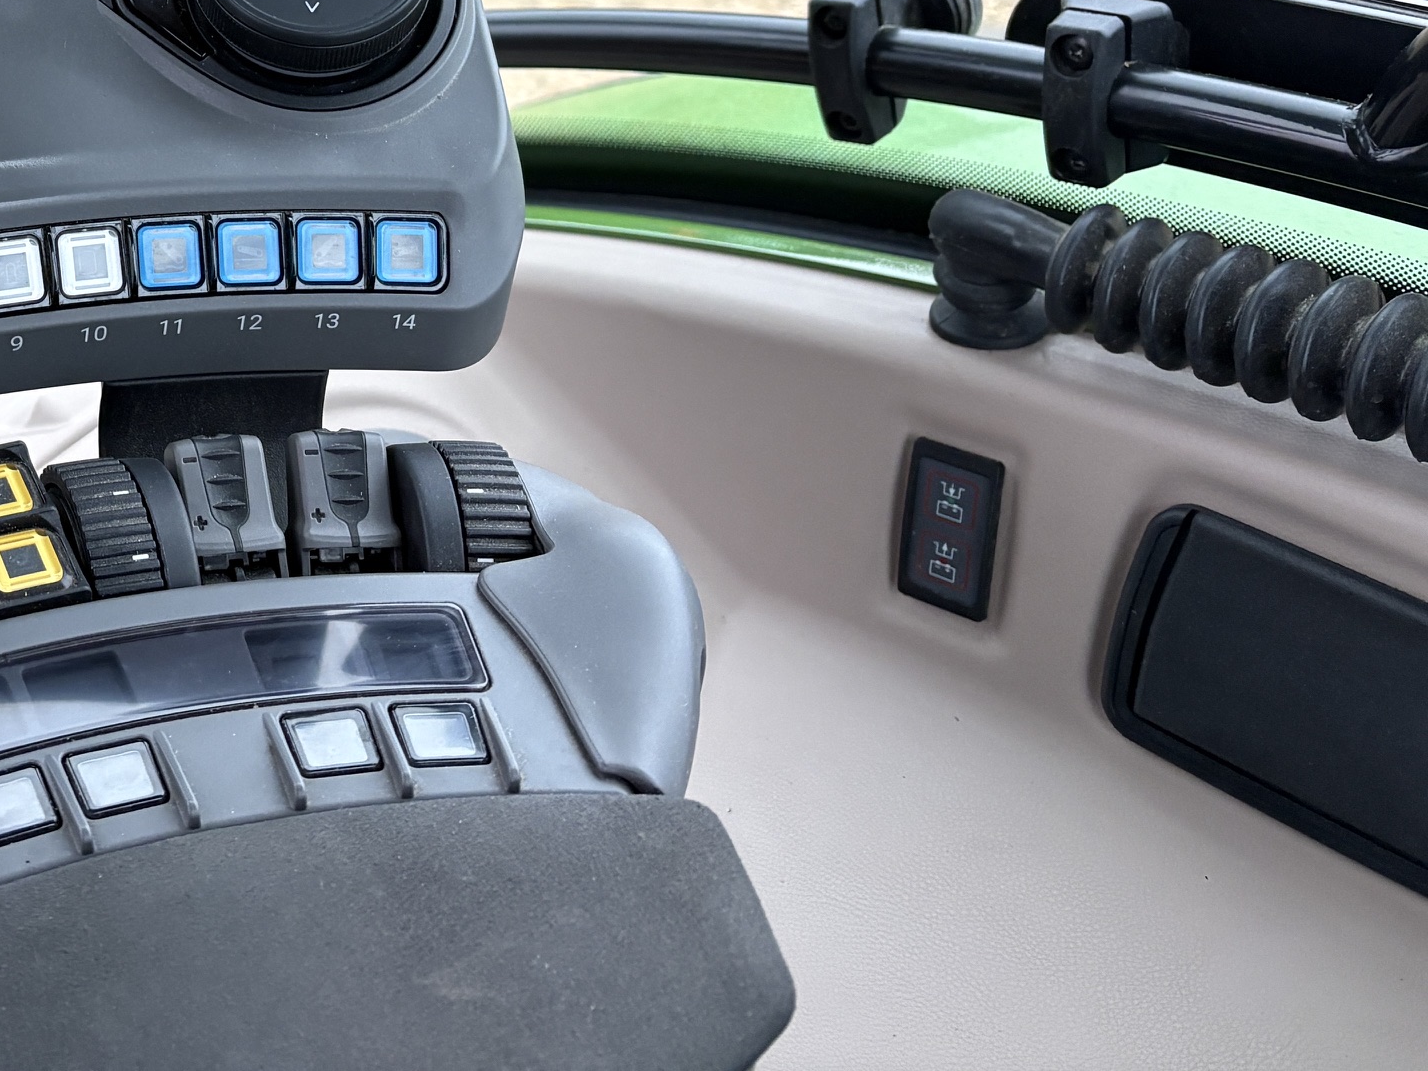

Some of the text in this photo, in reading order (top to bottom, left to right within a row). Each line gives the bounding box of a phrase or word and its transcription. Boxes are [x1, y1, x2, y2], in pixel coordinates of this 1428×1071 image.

[10, 335, 24, 352] 9
[80, 325, 108, 343] 10
[159, 318, 183, 336] 11
[237, 314, 263, 331] 12
[314, 312, 340, 329] 13
[392, 313, 416, 330] 14
